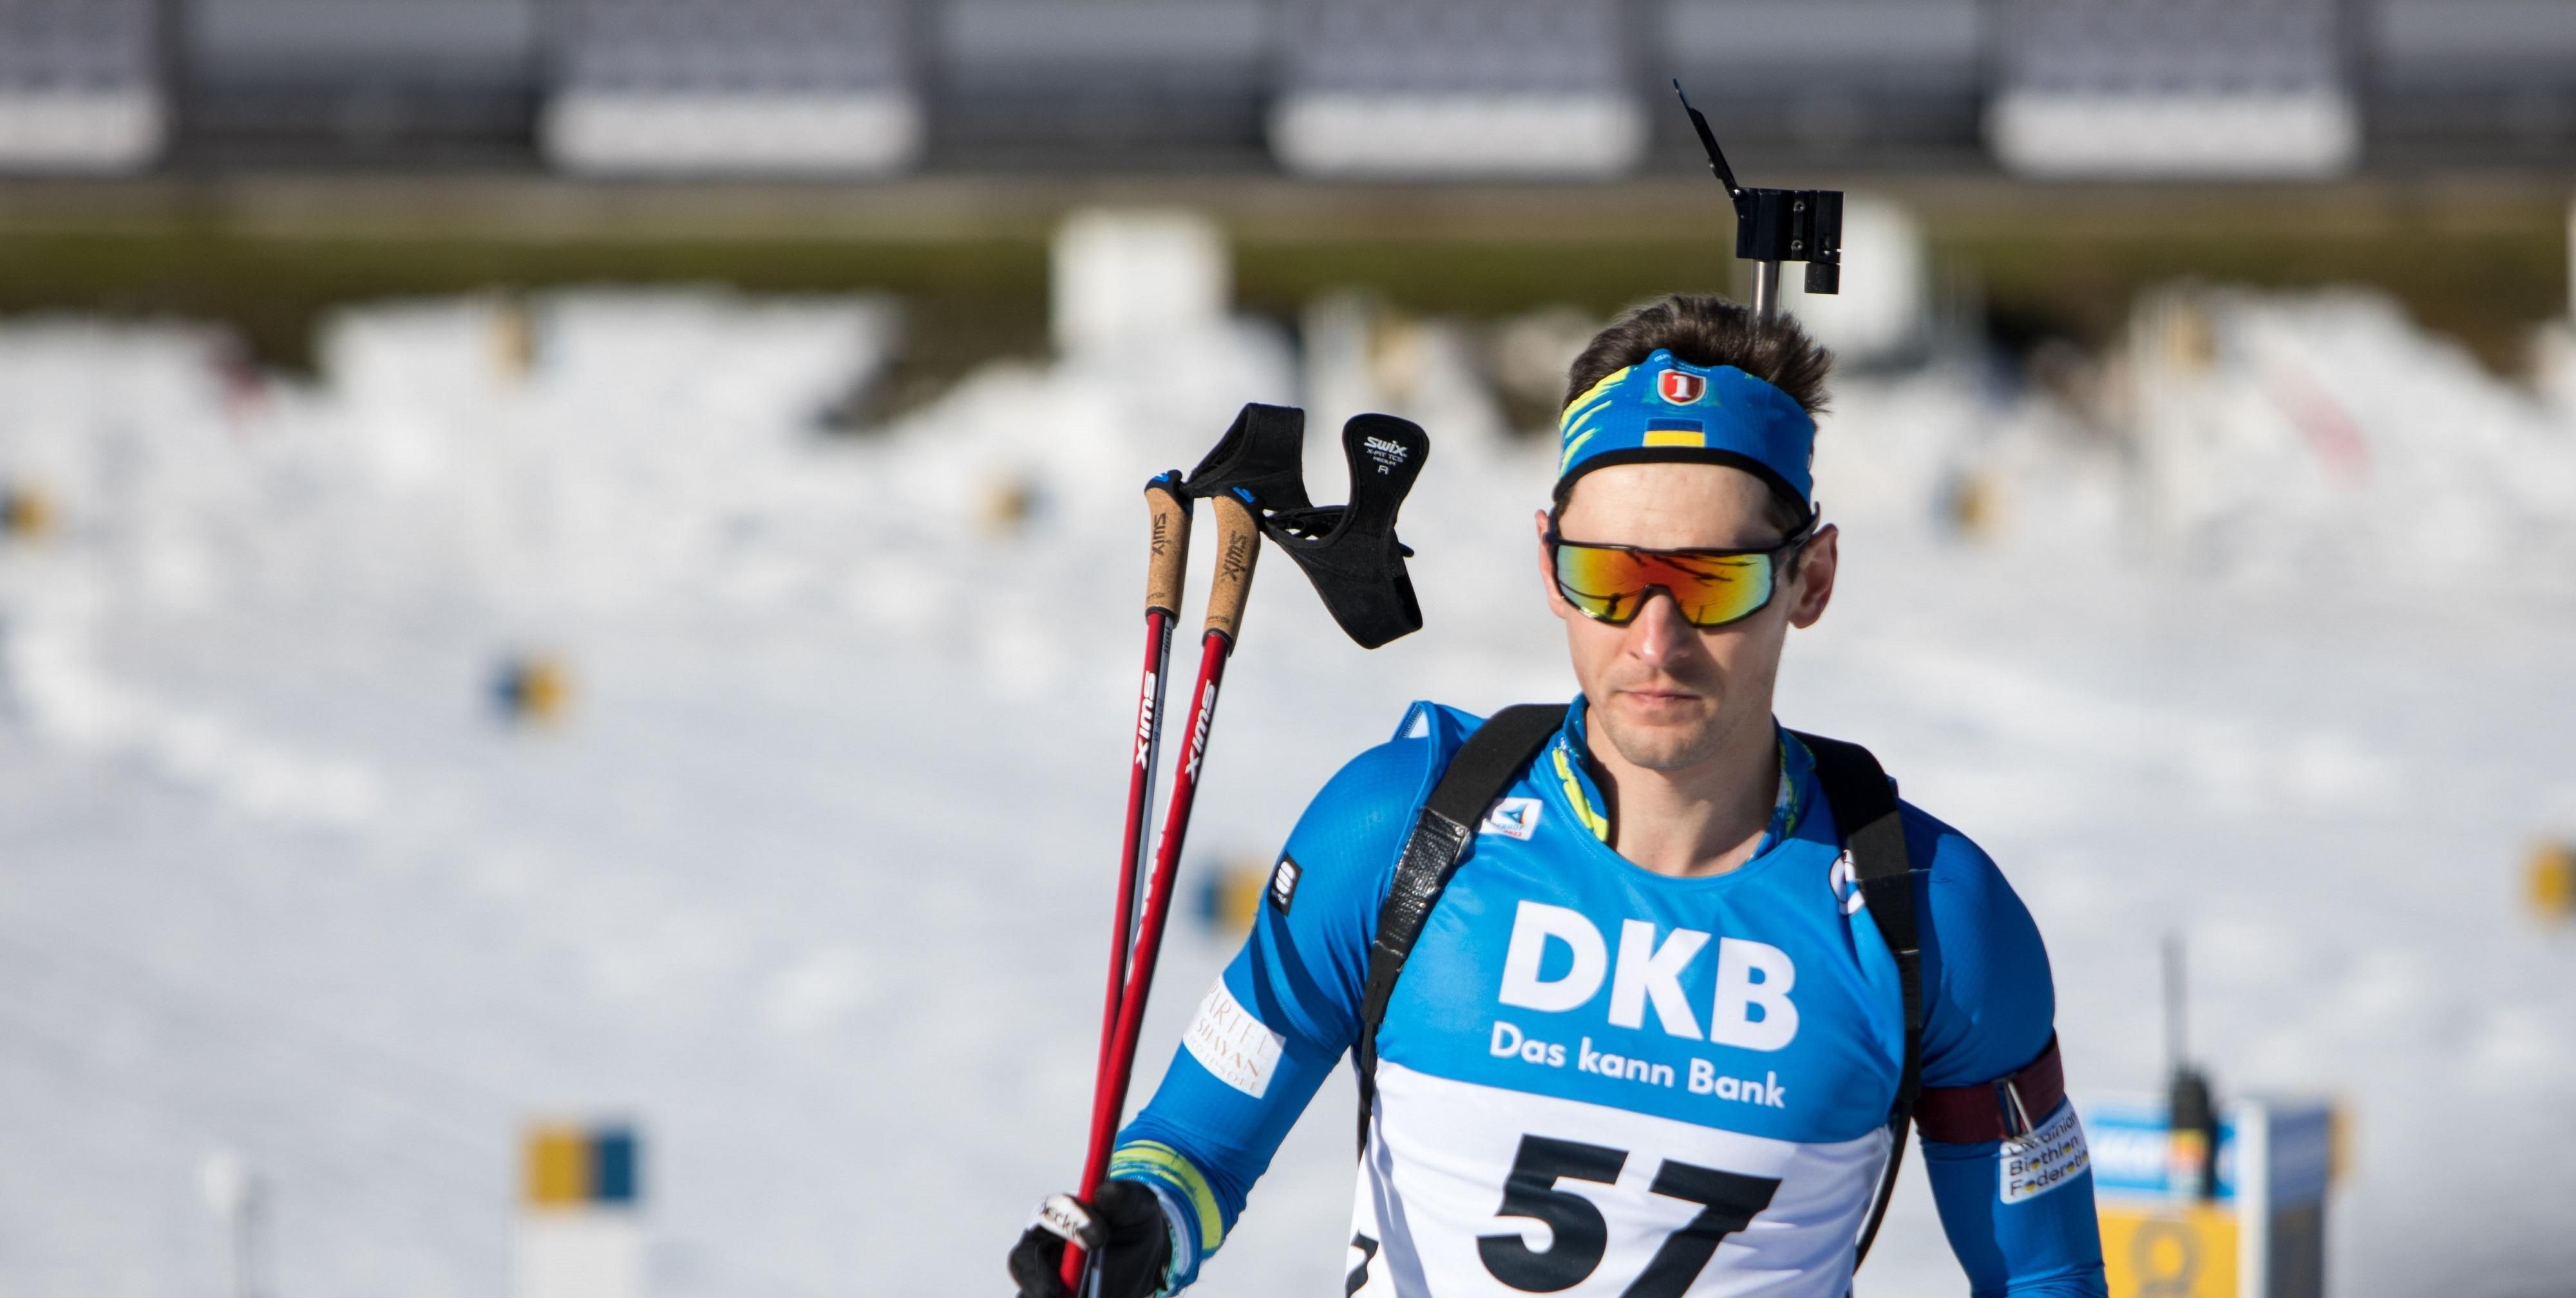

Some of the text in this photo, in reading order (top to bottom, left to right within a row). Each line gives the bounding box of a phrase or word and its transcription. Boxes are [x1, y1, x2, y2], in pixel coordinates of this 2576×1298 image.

[1670, 375, 1692, 398] 1
[1498, 900, 1800, 1052] DKB
[1490, 1021, 1786, 1109] Das kann Bank
[1475, 1133, 1783, 1298] 57
